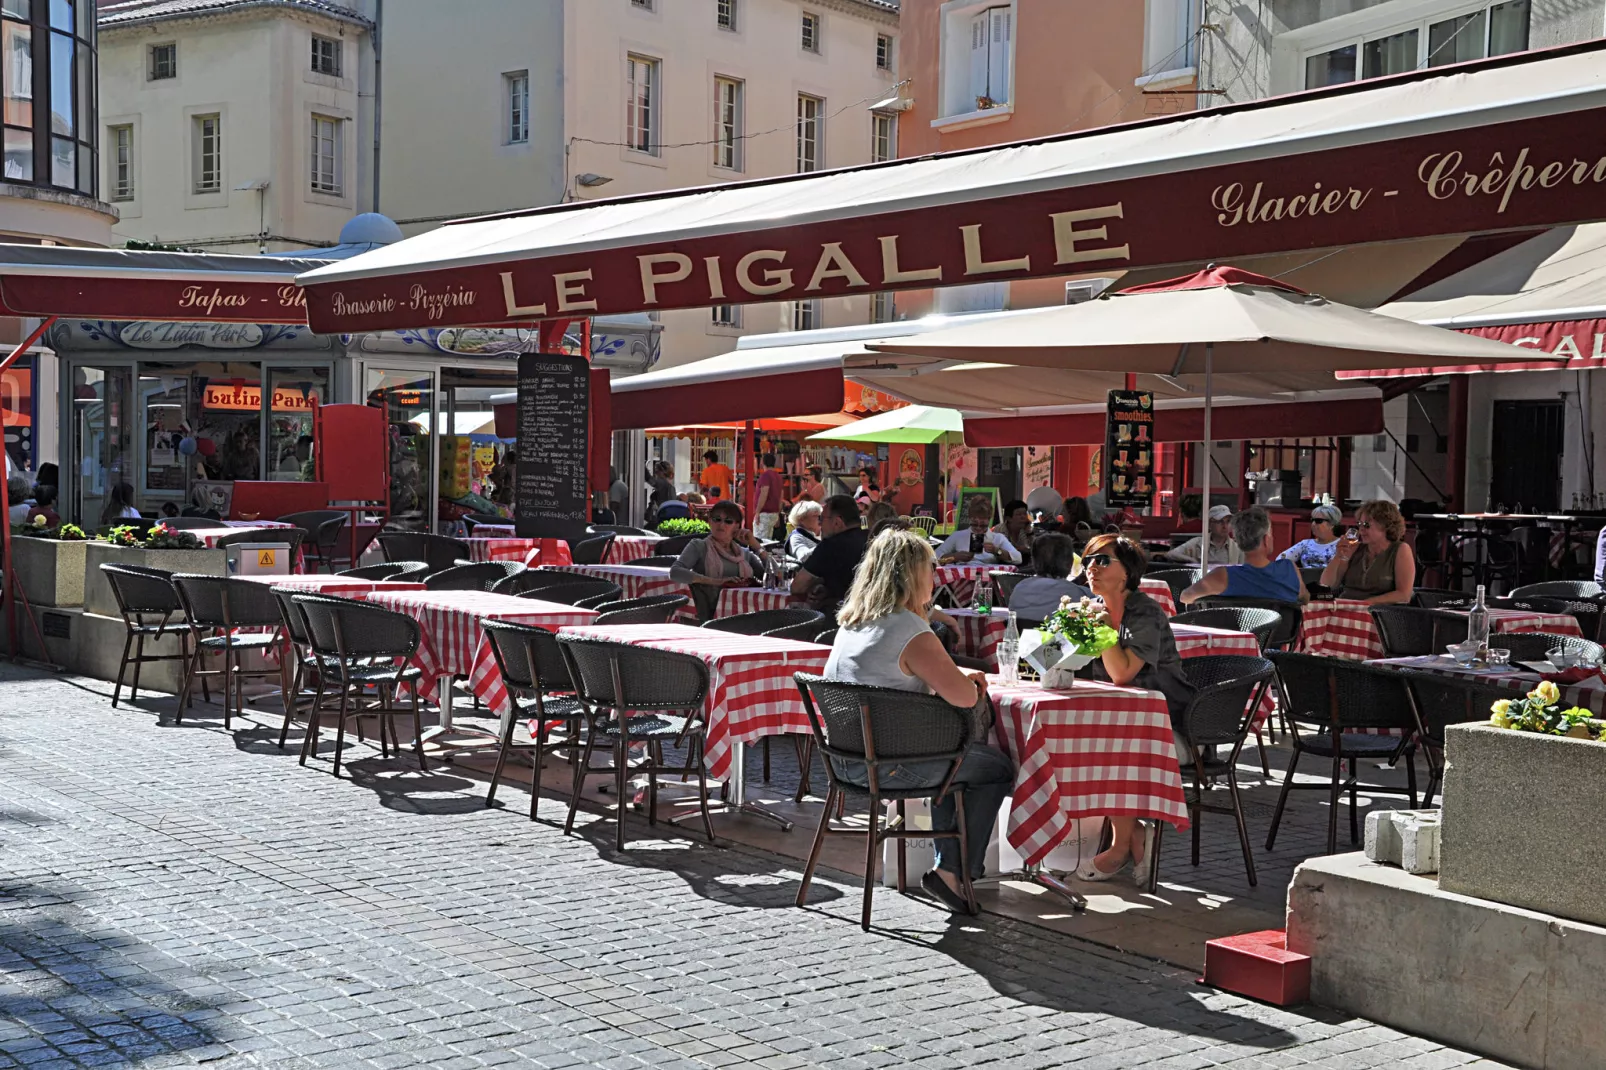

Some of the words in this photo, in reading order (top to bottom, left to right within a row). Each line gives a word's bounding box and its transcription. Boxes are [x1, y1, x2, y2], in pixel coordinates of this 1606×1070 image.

[1211, 181, 1372, 227] Glacier
[499, 268, 598, 317] LE
[636, 201, 1130, 305] PIGALLE
[178, 285, 252, 316] Tapas
[331, 291, 398, 317] Brasserie
[409, 283, 477, 320] Pizzéria
[124, 321, 152, 343] Le
[210, 322, 261, 343] Park
[207, 389, 260, 406] Lutin
